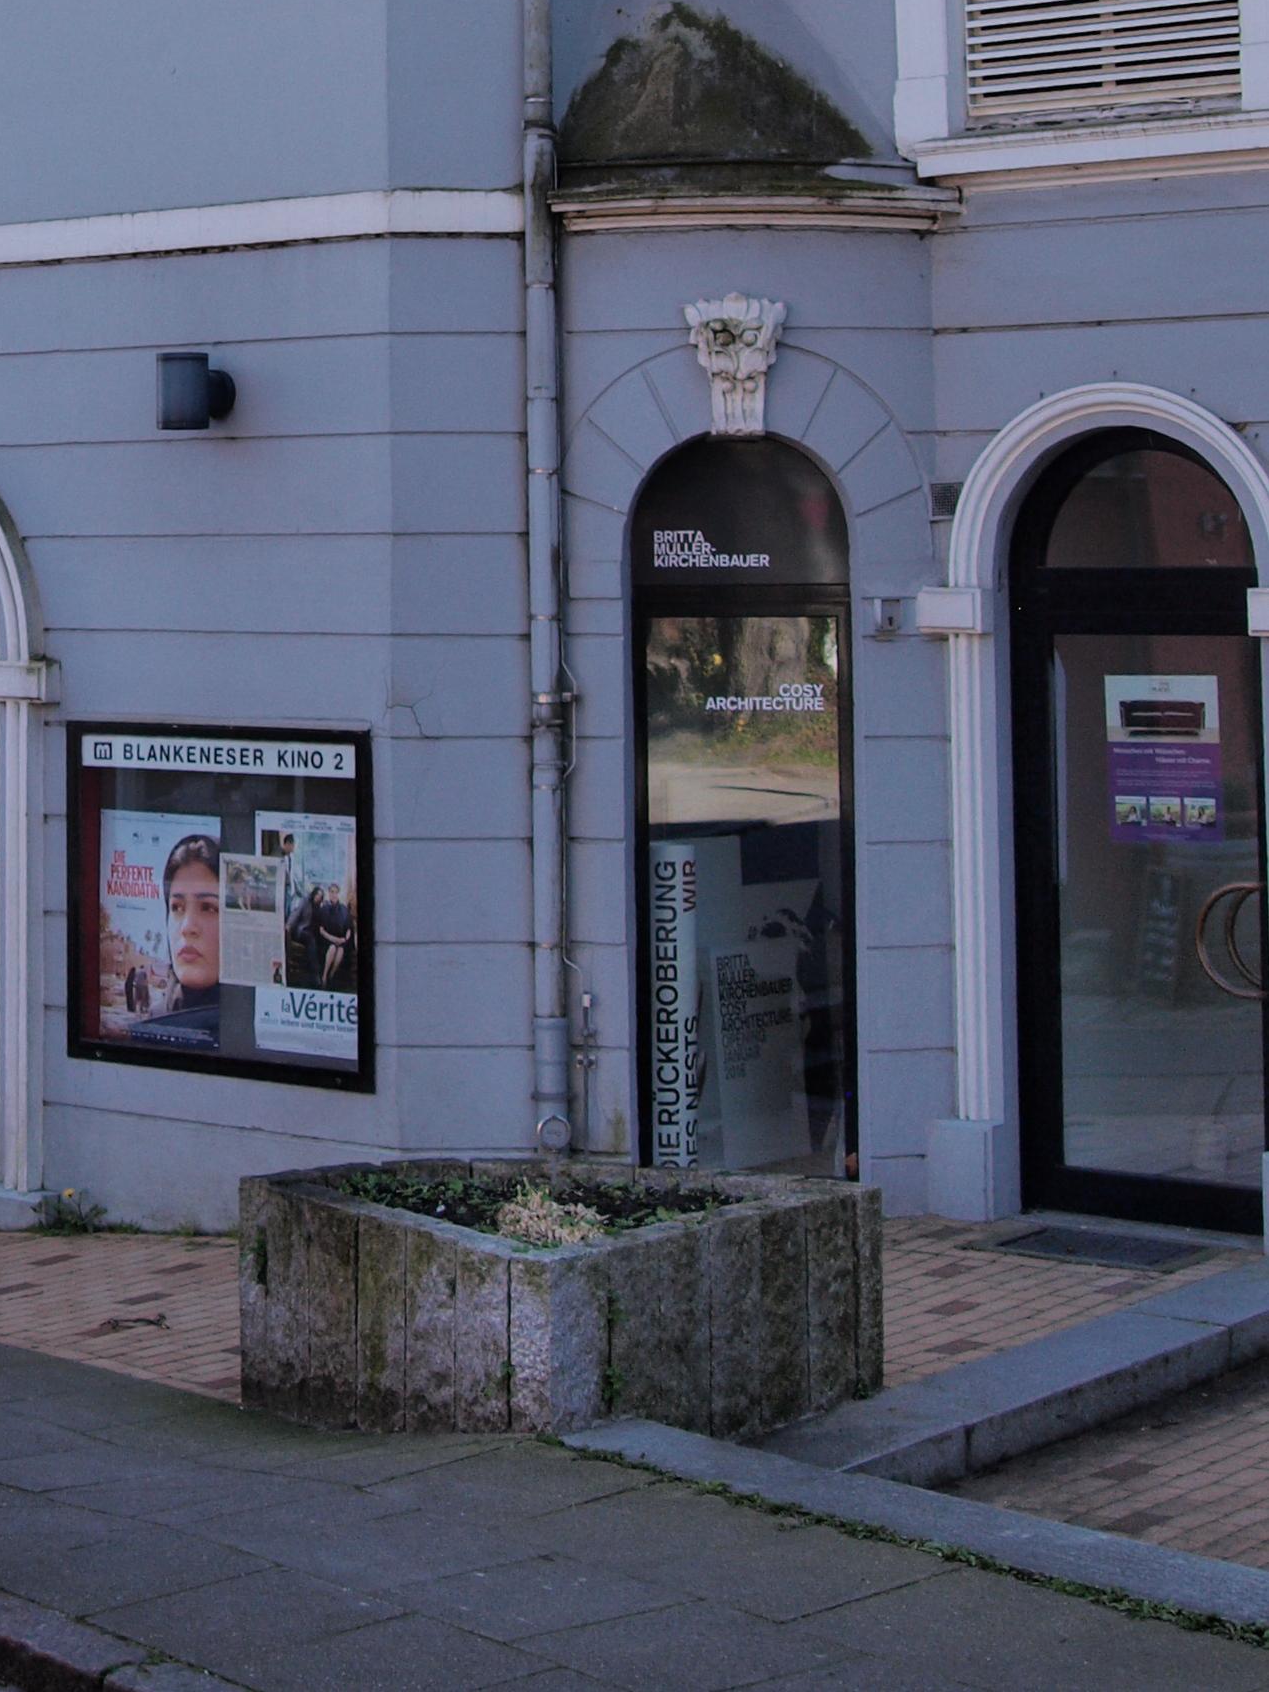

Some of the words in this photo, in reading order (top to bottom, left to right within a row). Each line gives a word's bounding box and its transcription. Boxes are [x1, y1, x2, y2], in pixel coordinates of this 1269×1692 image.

[653, 530, 705, 543] BRITTA
[653, 554, 770, 567] KIRCHENBAUER
[779, 683, 825, 697] COSY
[705, 696, 825, 711] ARCHITECTURE
[123, 743, 264, 767] BLANKENESER
[277, 750, 323, 769] KINO
[334, 753, 344, 770] 2
[111, 863, 154, 882] PERFEKTE
[106, 879, 159, 900] KANDIDATIN
[683, 860, 696, 912] WIR
[652, 861, 680, 1126] RÜCKEROBERUNG
[281, 999, 290, 1013] la
[290, 991, 358, 1025] Vérité
[684, 1015, 699, 1110] NESTS
